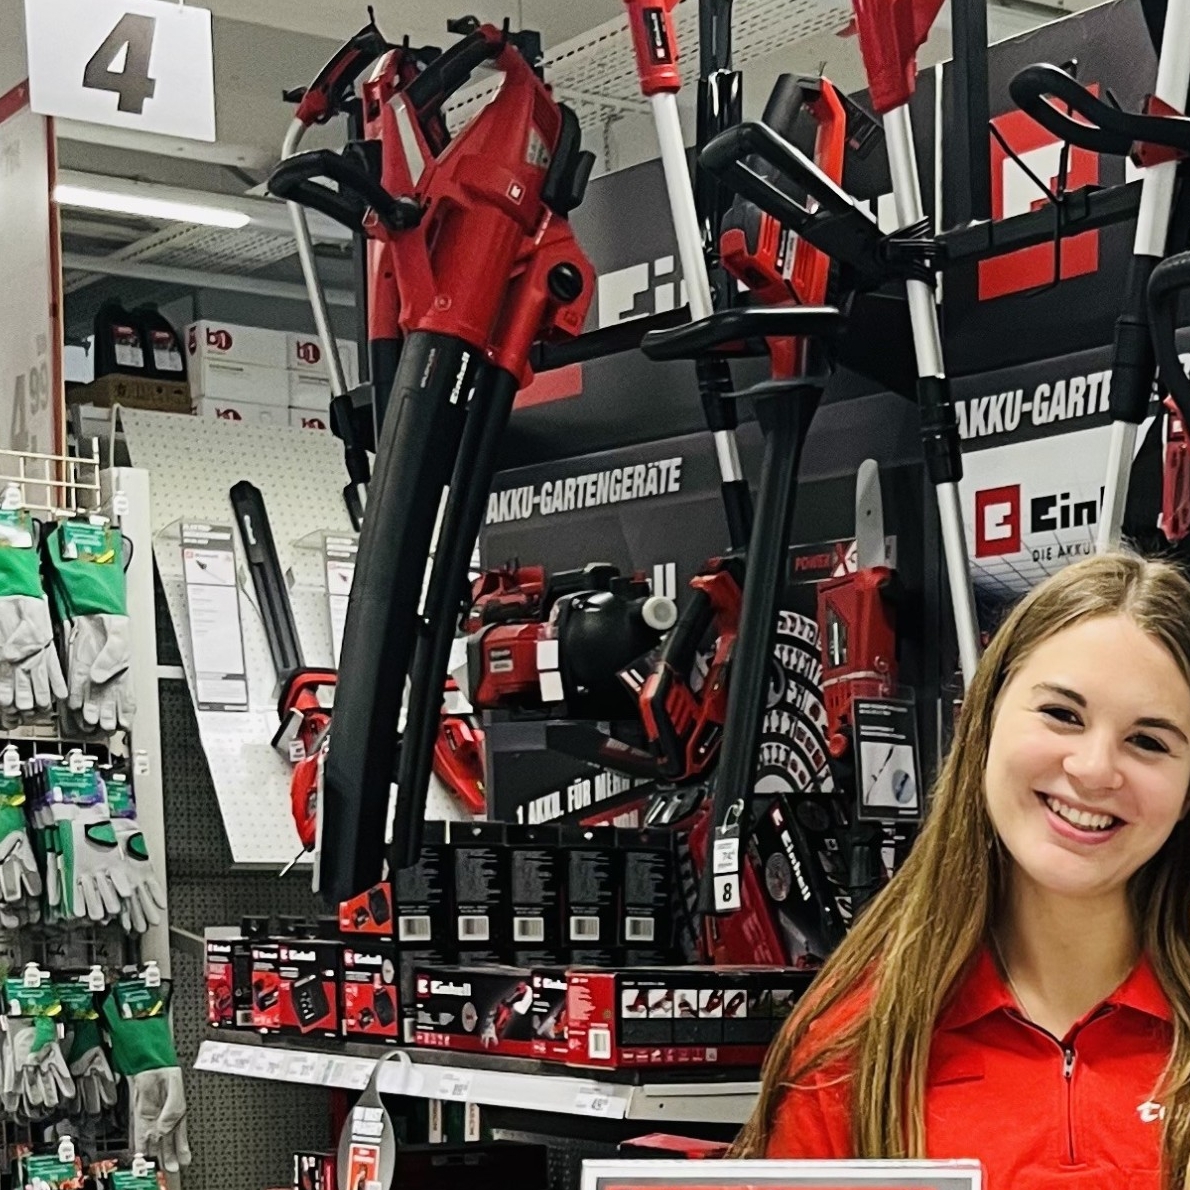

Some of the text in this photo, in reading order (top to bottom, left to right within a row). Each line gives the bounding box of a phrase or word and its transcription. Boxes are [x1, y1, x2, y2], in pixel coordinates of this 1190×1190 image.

[82, 12, 158, 115] 4
[485, 456, 683, 525] AKKU-GARTENGERÄTE
[722, 882, 733, 902] 8
